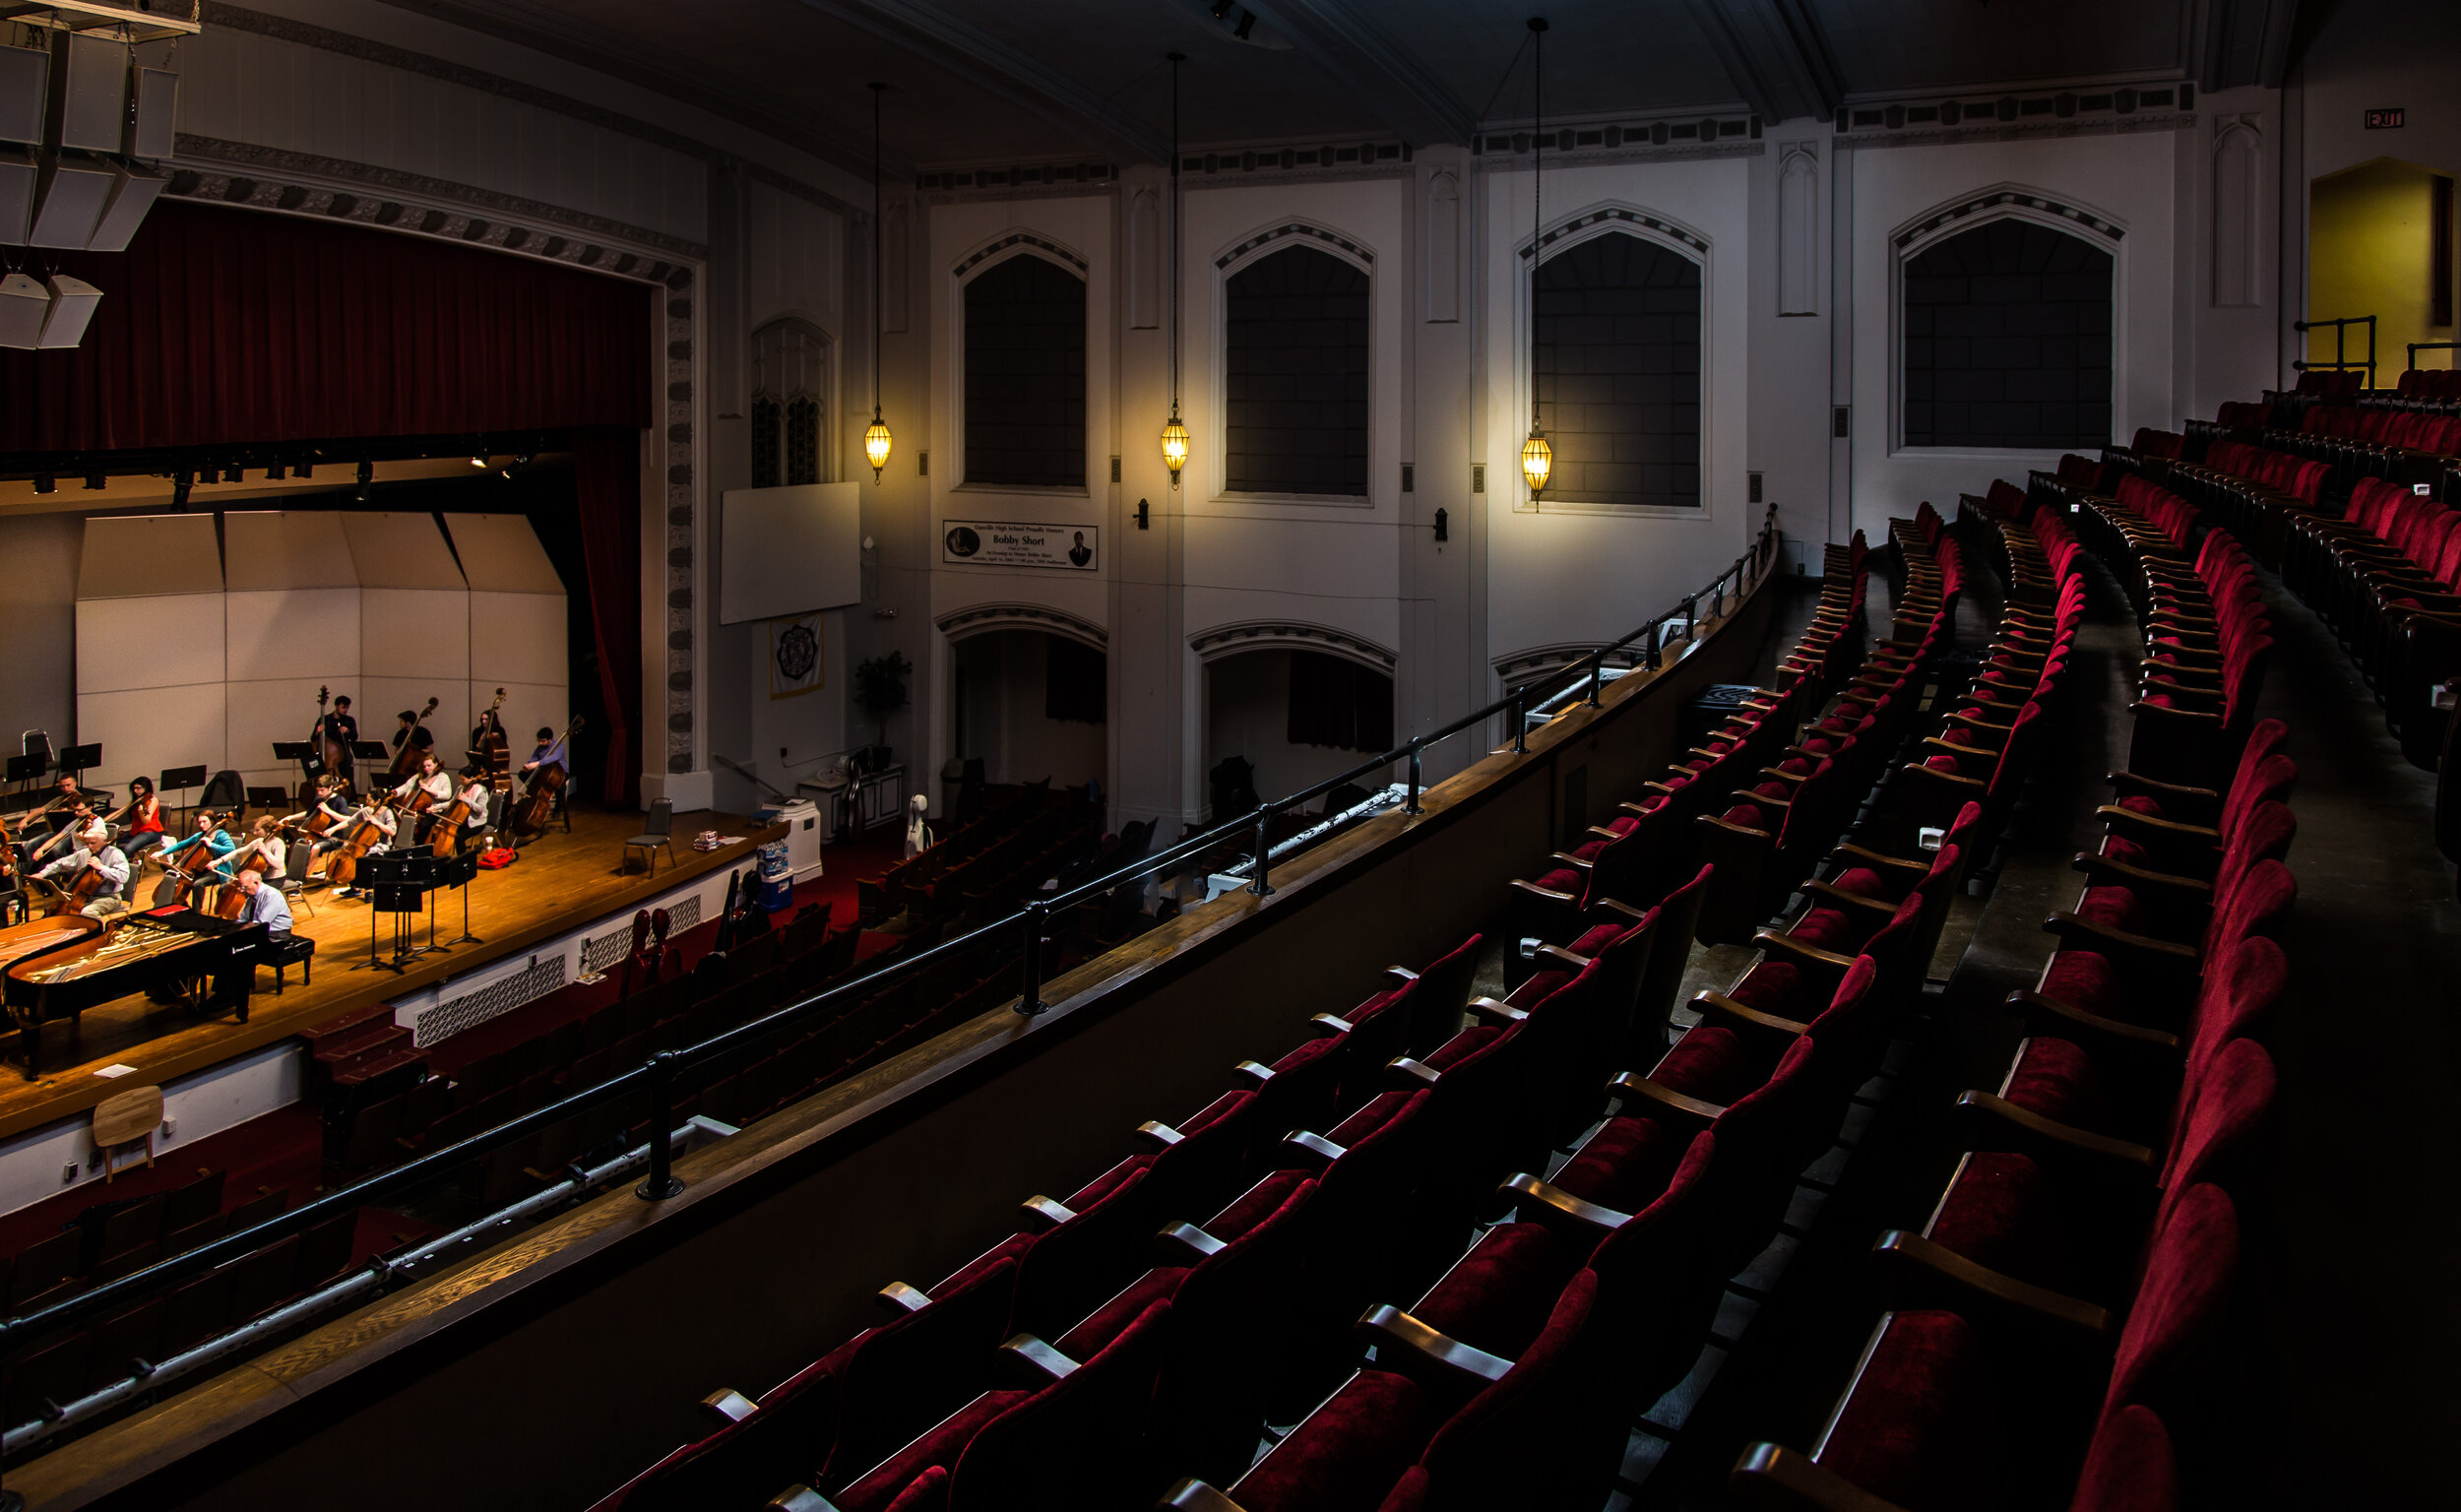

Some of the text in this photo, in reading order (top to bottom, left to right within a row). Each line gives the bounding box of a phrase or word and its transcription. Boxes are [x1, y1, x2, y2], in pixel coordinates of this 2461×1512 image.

[2369, 110, 2401, 126] EXIT
[993, 535, 1044, 546] Bobby Short
